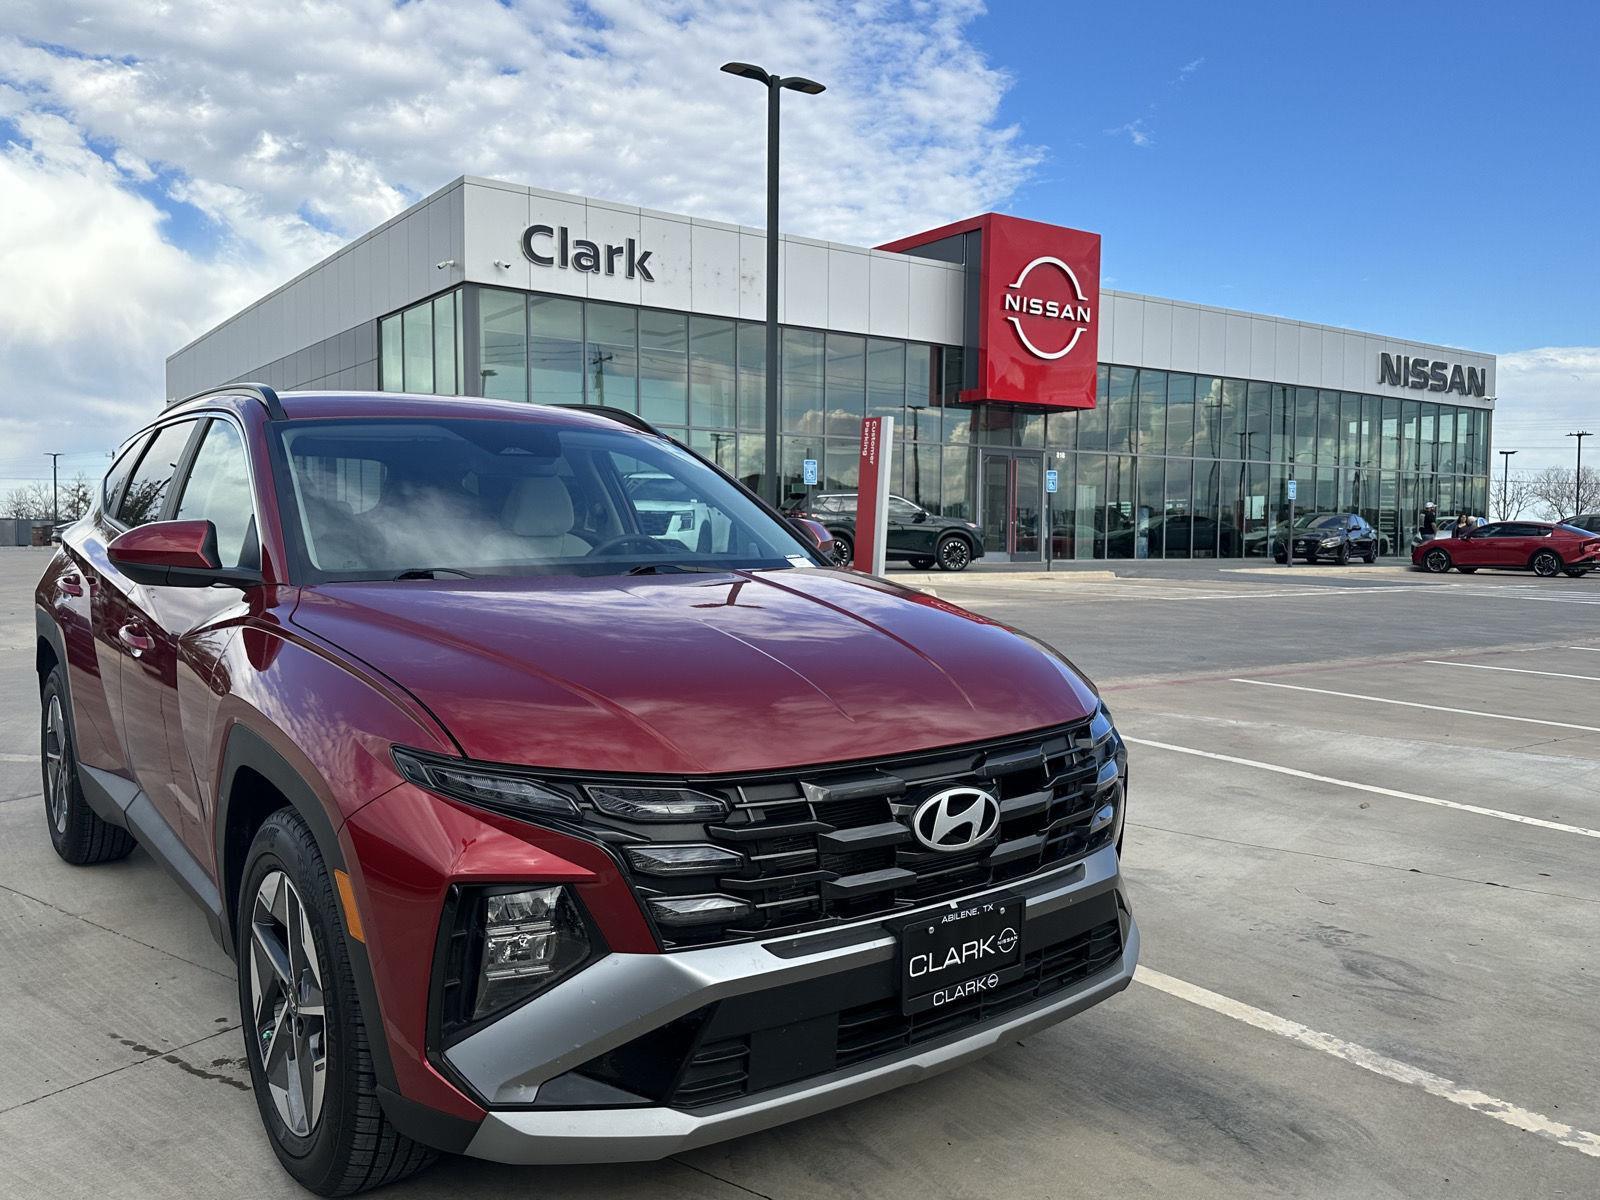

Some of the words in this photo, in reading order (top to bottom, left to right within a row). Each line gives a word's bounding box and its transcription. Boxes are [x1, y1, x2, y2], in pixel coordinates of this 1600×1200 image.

[522, 224, 655, 282] Clark
[1005, 293, 1091, 323] NISSAN
[1379, 352, 1486, 398] NISSAN
[862, 421, 870, 456] Parking
[982, 904, 994, 912] TX
[910, 935, 995, 977] CLARK
[933, 977, 987, 1005] CLARK
